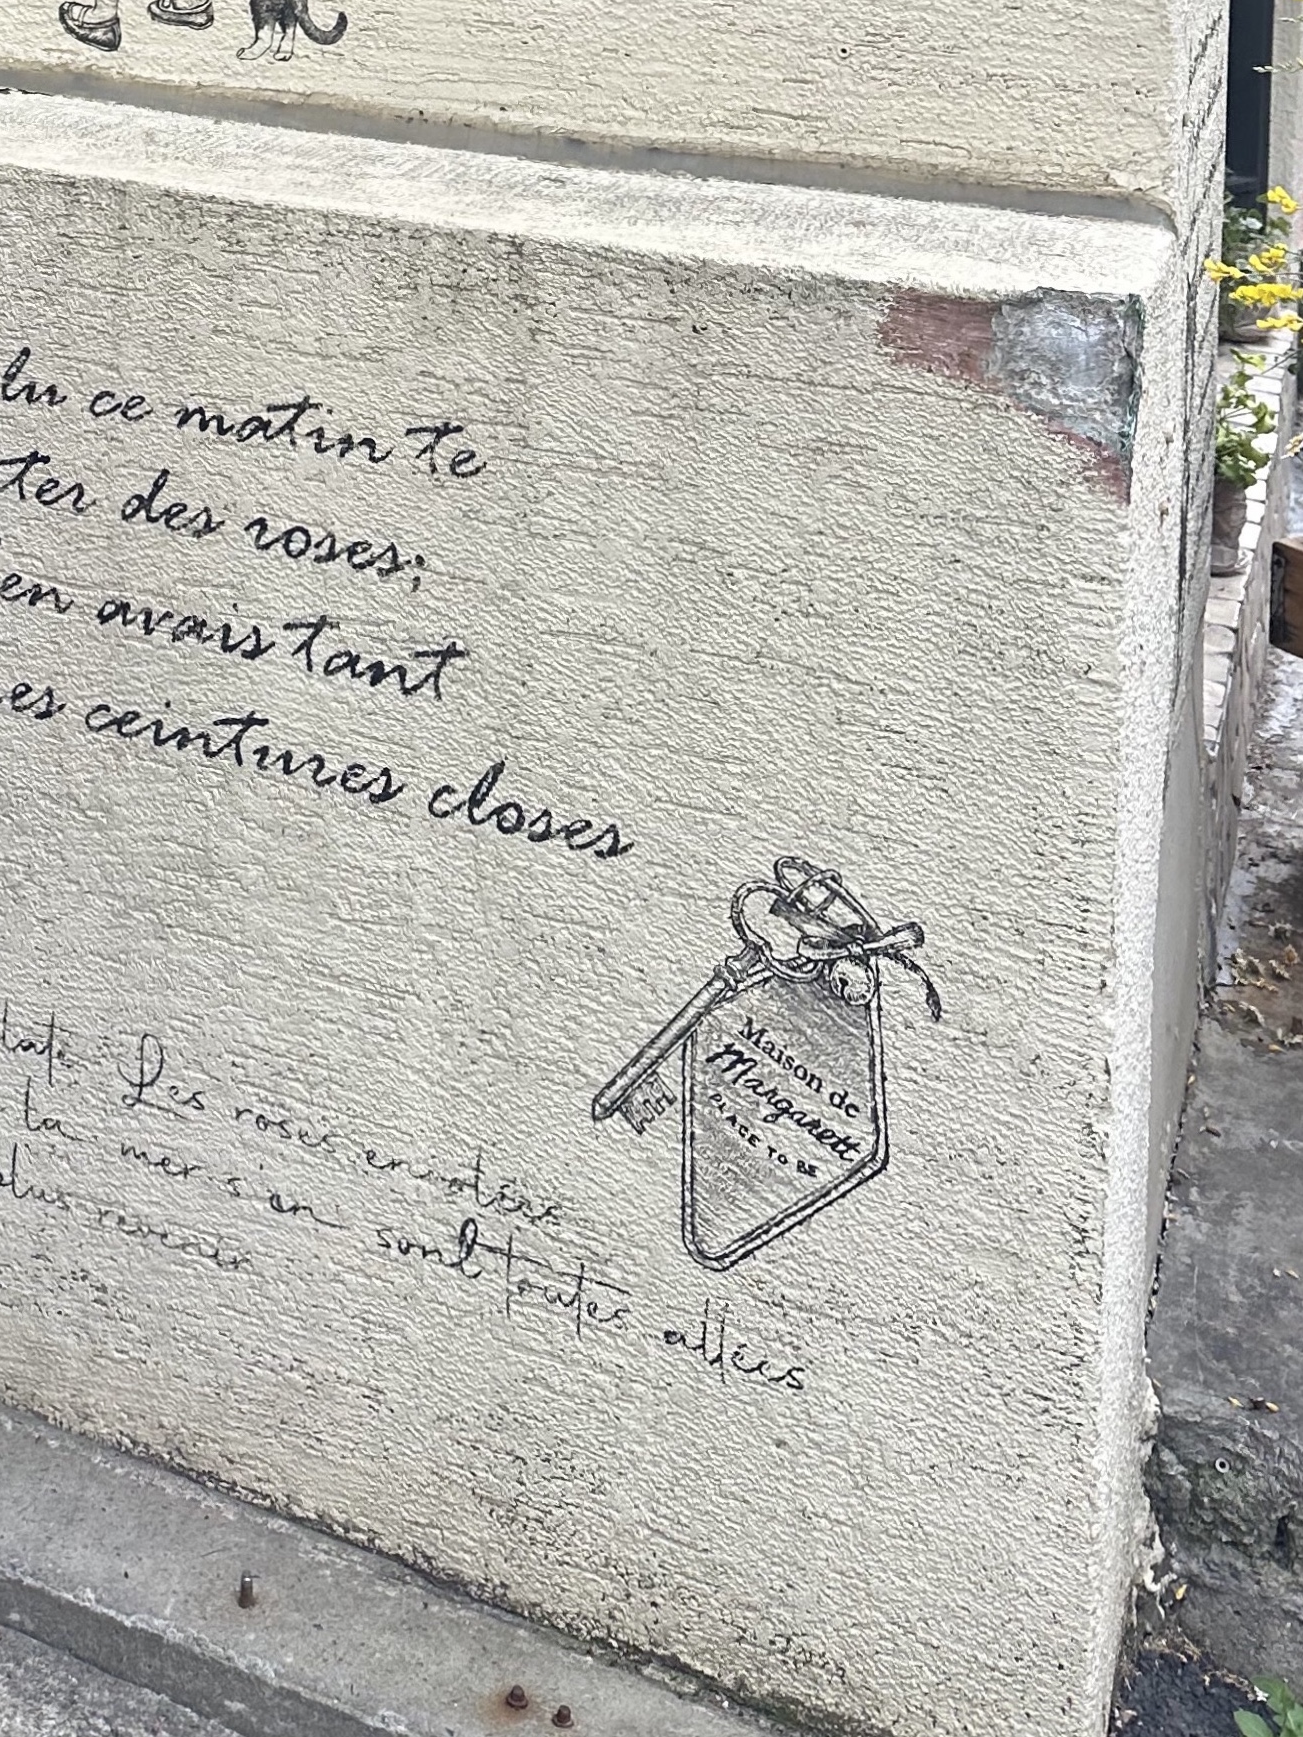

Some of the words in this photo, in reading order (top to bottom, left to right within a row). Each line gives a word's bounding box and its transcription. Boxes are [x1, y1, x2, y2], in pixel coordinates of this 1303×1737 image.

[90, 387, 152, 422] ce
[177, 395, 396, 465] matin
[406, 422, 487, 479] te
[121, 469, 224, 540] des
[244, 510, 426, 594] roses;
[97, 586, 276, 660] avais
[282, 614, 471, 702] tant
[85, 700, 404, 805] ceintures
[427, 759, 635, 862] closes
[22, 1076, 98, 1142] la
[705, 1042, 862, 1163] Margarett
[739, 1016, 825, 1094] Maison
[829, 1090, 861, 1120] de
[767, 1145, 788, 1166] TO
[797, 1159, 819, 1180] BE
